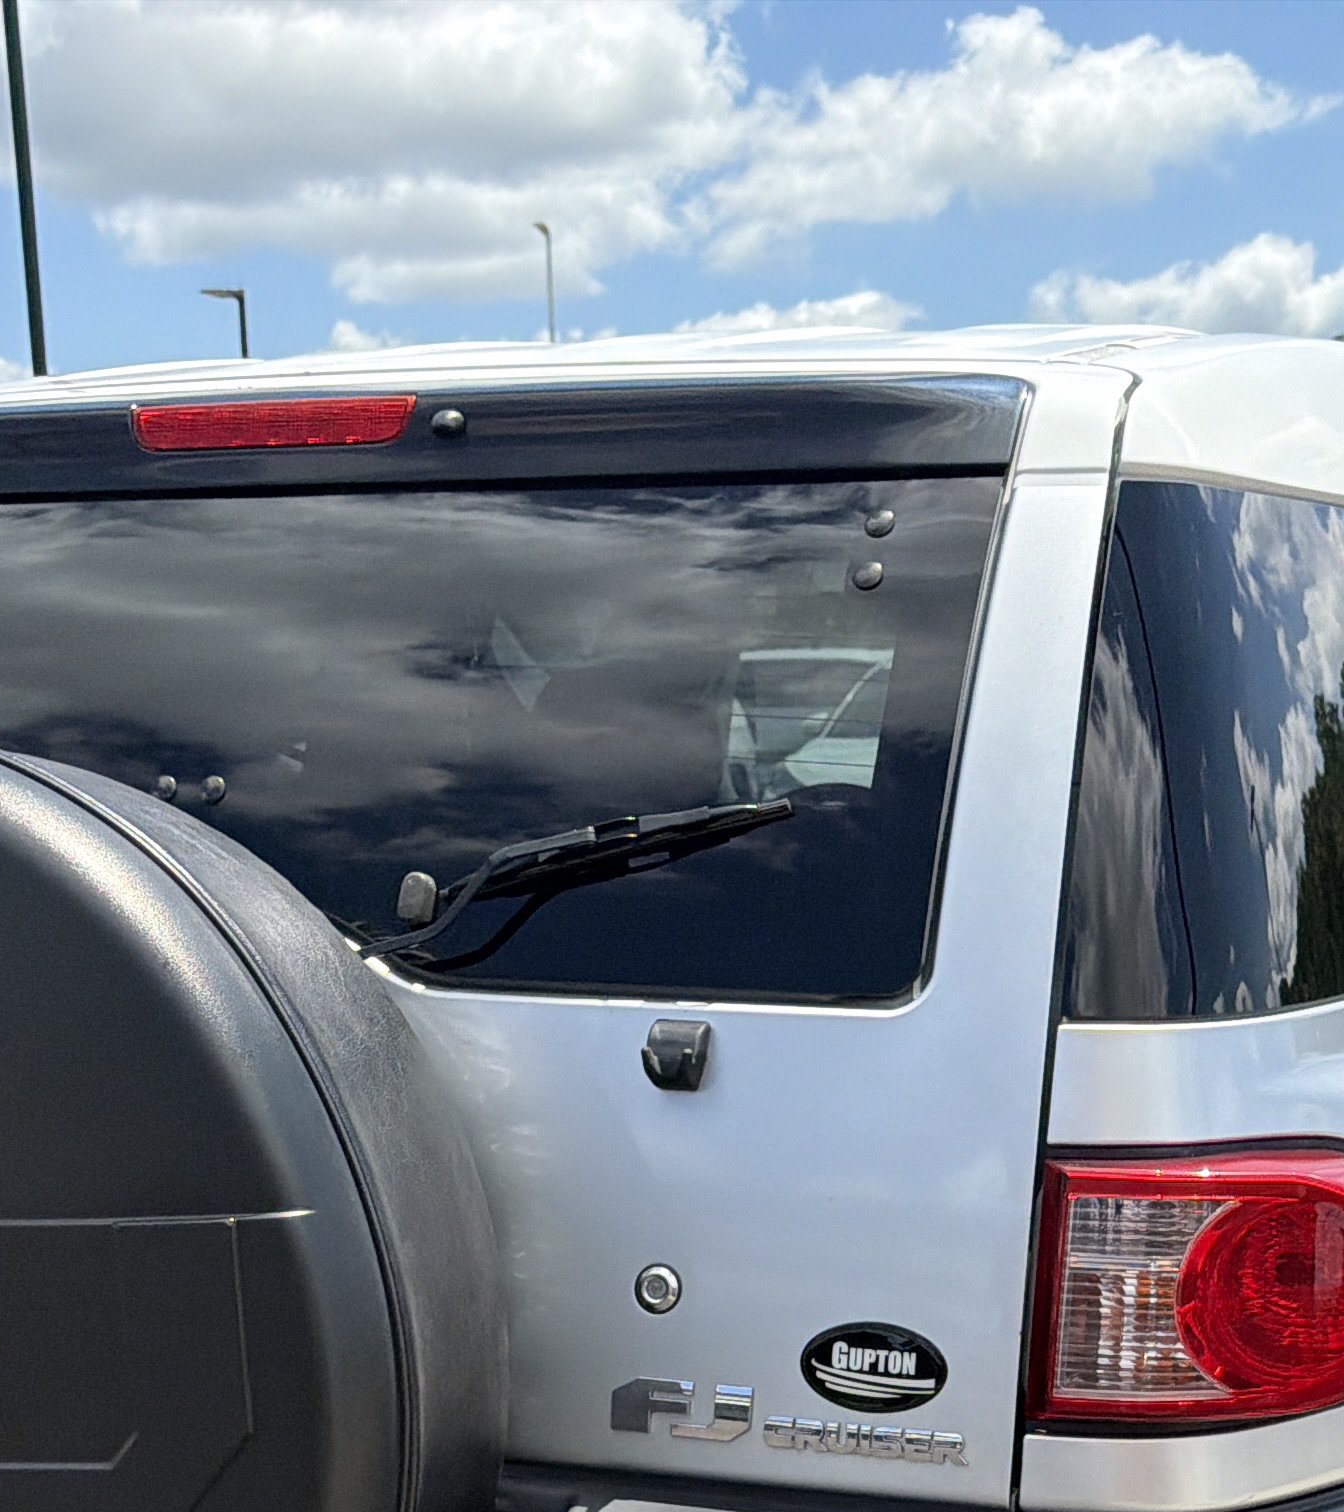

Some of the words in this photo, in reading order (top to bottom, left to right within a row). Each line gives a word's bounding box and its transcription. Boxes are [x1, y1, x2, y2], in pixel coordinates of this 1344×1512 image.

[831, 1340, 918, 1376] GUPTON
[610, 1376, 755, 1443] FJ
[762, 1415, 970, 1467] CRUISER
